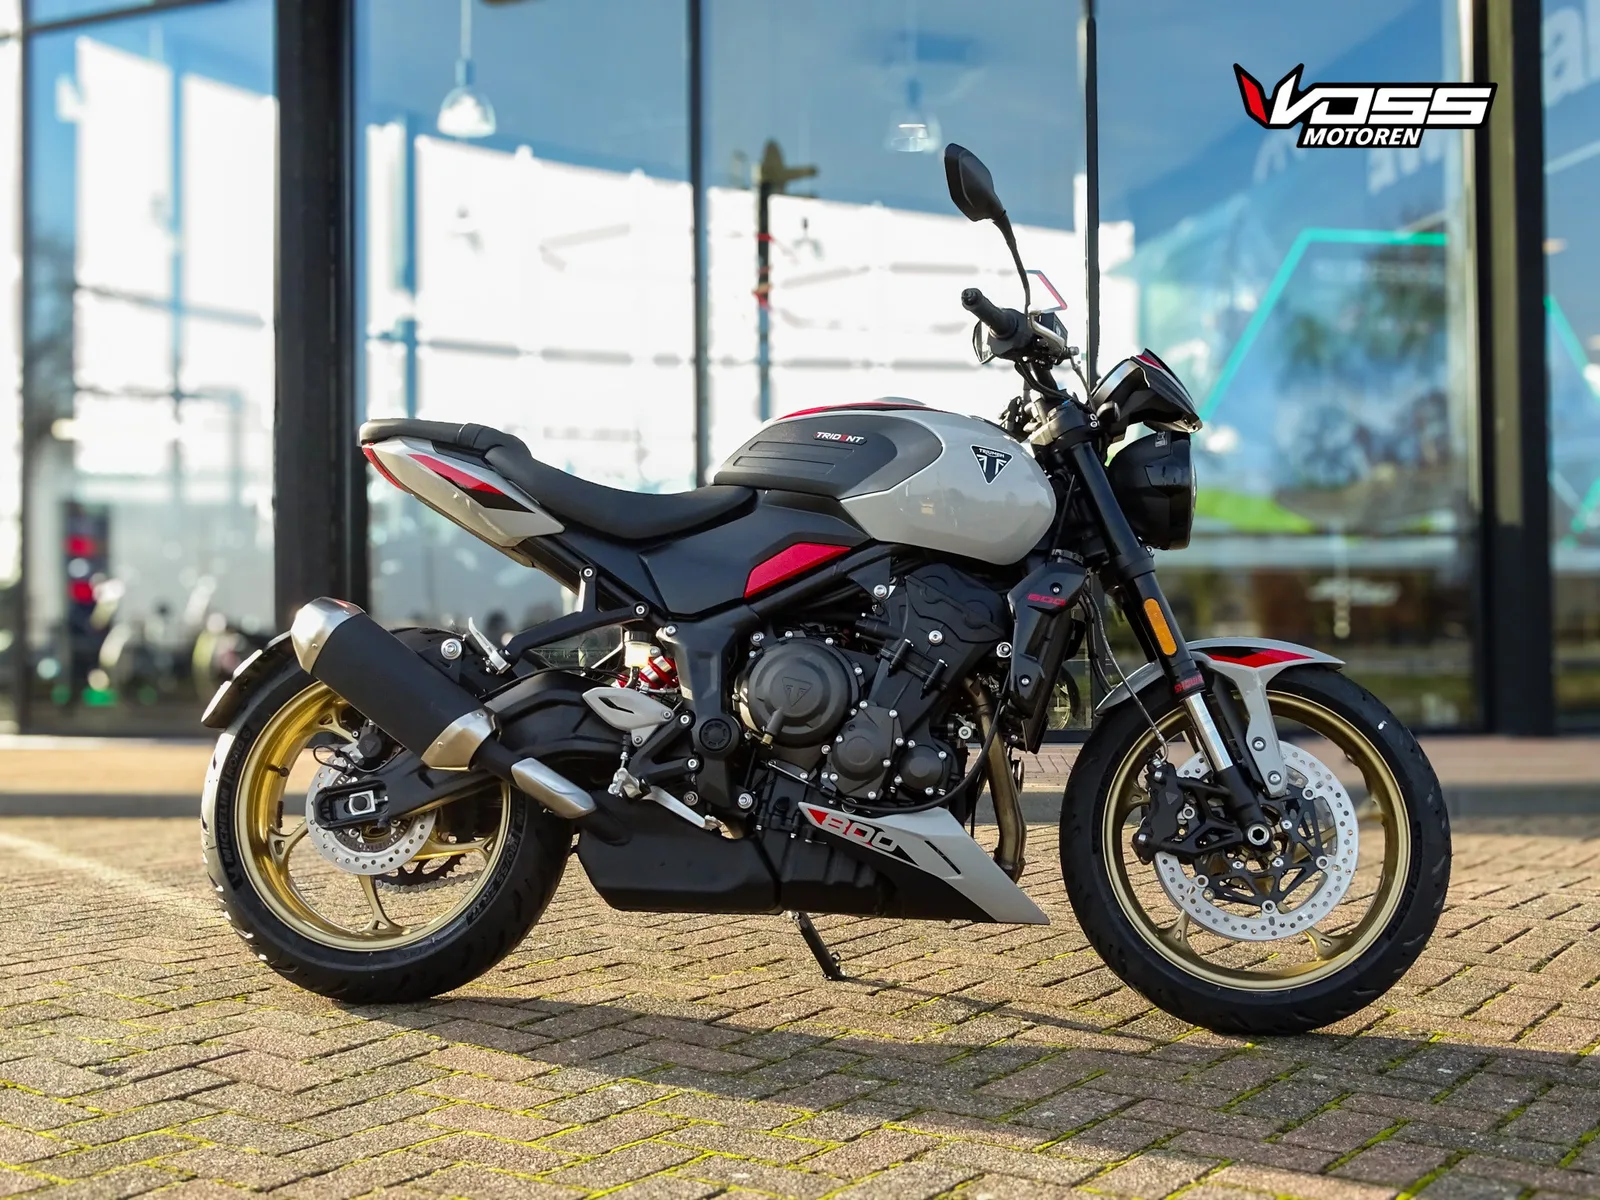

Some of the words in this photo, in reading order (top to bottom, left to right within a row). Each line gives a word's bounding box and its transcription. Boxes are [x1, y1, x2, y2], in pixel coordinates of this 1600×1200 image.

[816, 431, 865, 443] TRIDENT
[979, 448, 1005, 458] TRIUMPH
[217, 787, 235, 864] MICHELIN
[226, 738, 245, 777] ROAD
[821, 813, 899, 852] 800
